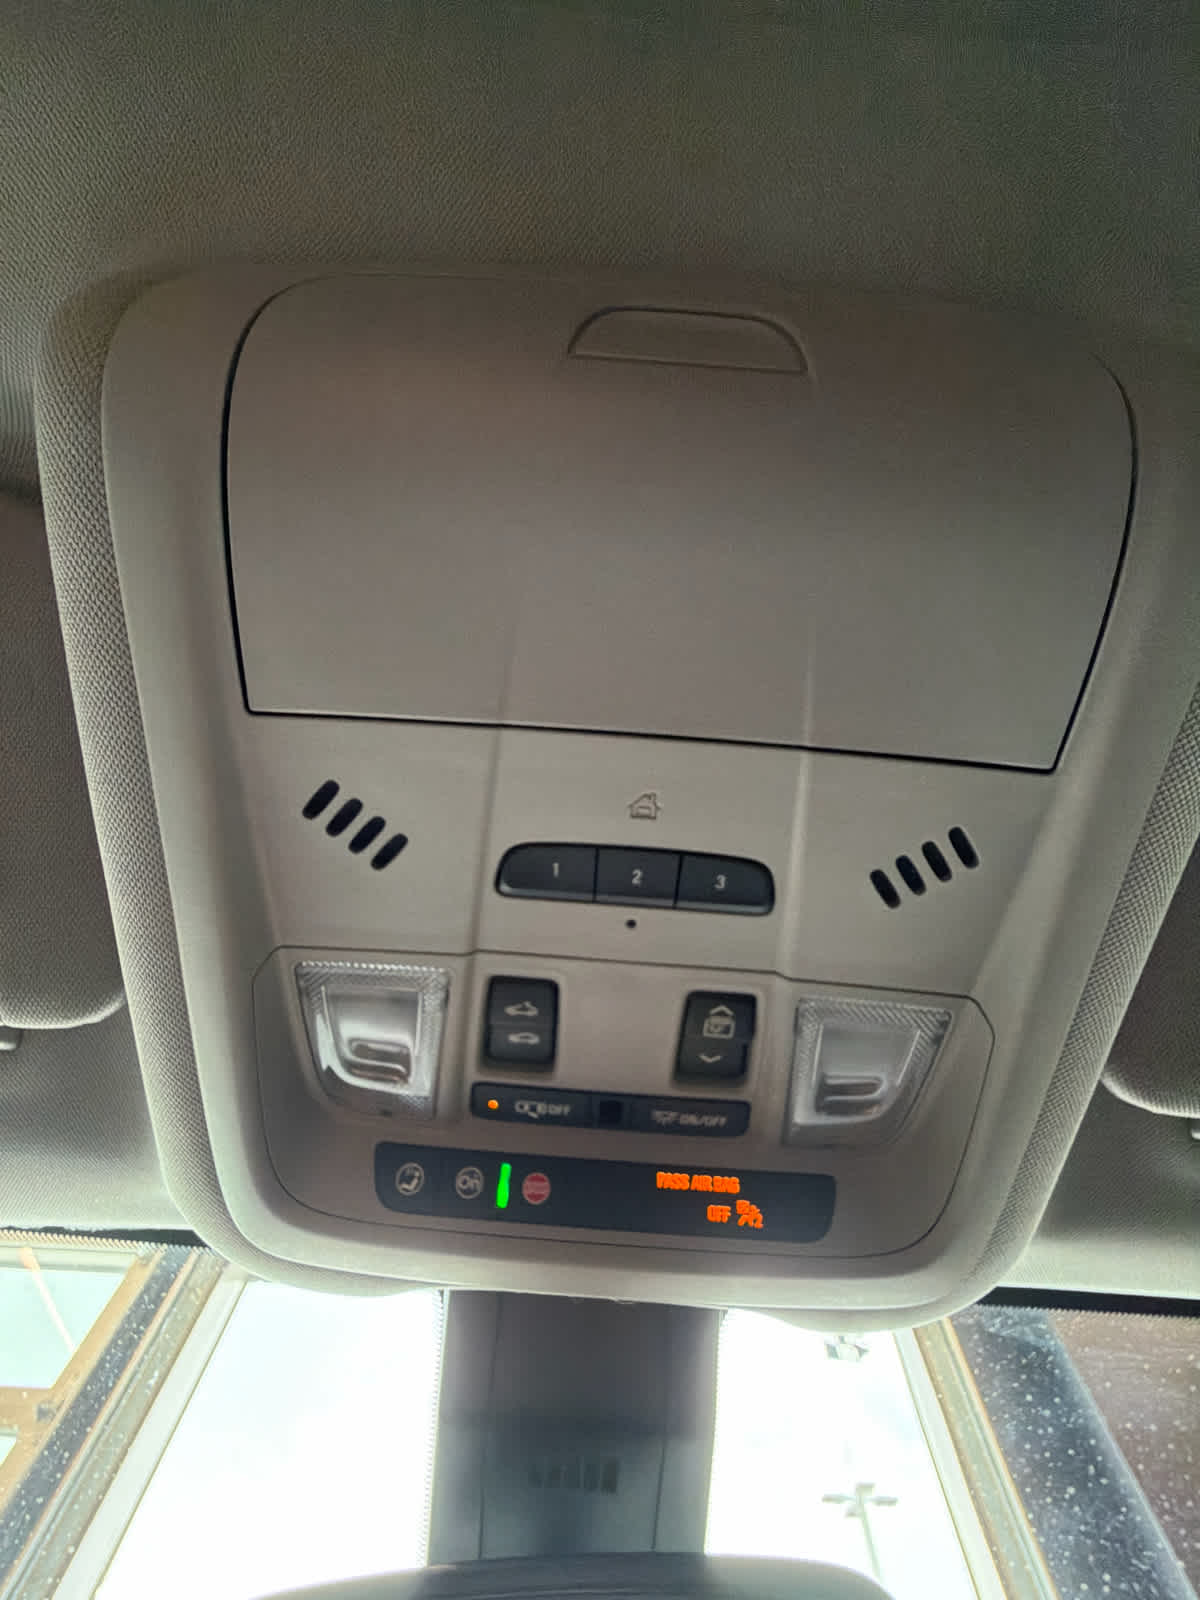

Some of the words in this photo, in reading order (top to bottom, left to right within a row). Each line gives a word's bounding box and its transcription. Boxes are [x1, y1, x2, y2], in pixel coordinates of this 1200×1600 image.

[552, 862, 560, 877] 1
[631, 869, 643, 885] 2
[714, 874, 728, 890] 3
[656, 1171, 690, 1191] PASS
